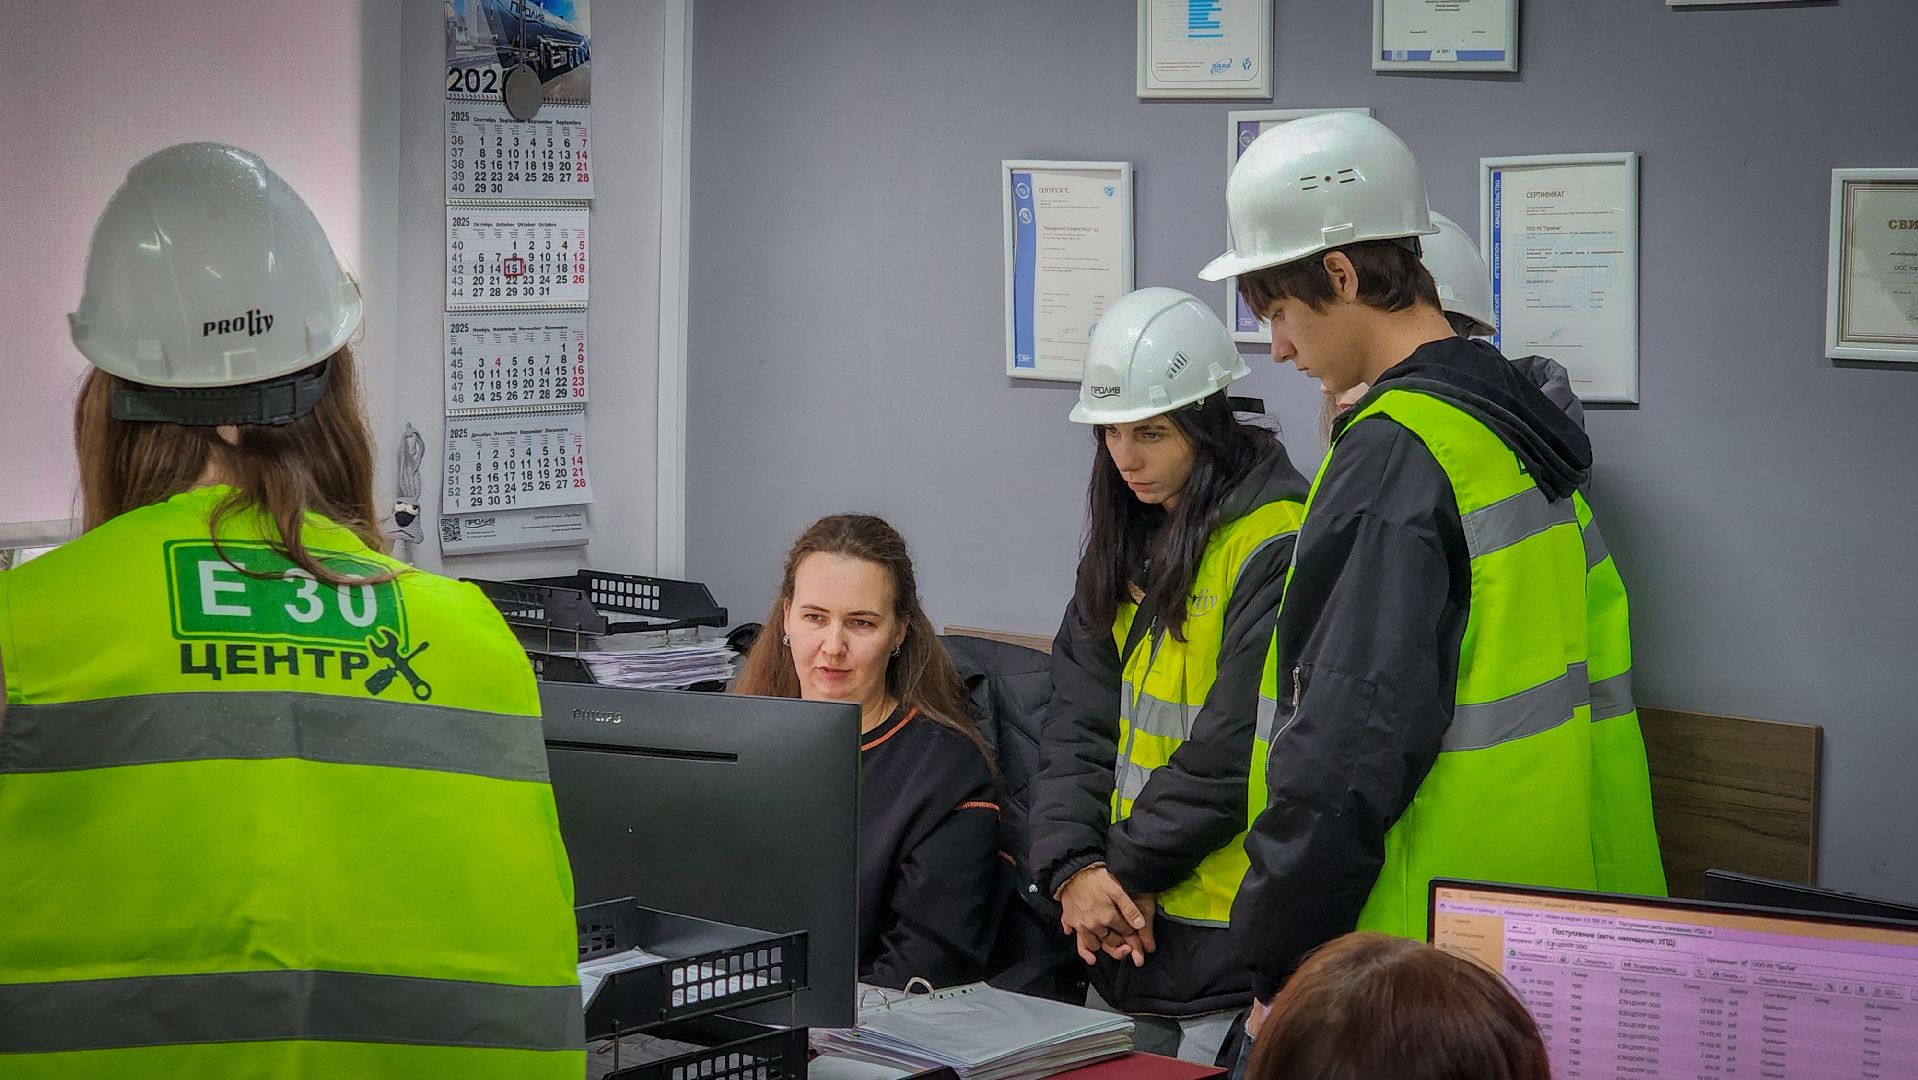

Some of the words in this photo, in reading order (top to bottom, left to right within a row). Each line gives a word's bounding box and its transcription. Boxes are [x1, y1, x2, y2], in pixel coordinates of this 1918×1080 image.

[448, 67, 498, 93] 202
[451, 112, 469, 121] 2025
[480, 136, 484, 146] 1
[497, 137, 502, 146] 2
[514, 137, 519, 146] 3
[530, 138, 536, 147] 4
[548, 138, 553, 147] 5
[564, 138, 570, 148] 6
[582, 139, 587, 148] 7
[480, 148, 486, 158] 8
[497, 149, 502, 158] 9
[508, 149, 519, 158] 10
[525, 149, 535, 158] 11
[542, 150, 553, 159] 12
[559, 150, 570, 159] 13
[576, 151, 587, 160] 14
[474, 160, 486, 169] 15
[491, 160, 502, 170] 16
[508, 161, 519, 170] 17
[525, 161, 536, 170] 18
[542, 161, 553, 170] 19
[559, 162, 571, 171] 20
[576, 162, 587, 171] 21
[475, 172, 486, 181] 22
[491, 172, 502, 181] 23
[508, 172, 519, 181] 24
[525, 172, 536, 182] 25
[542, 173, 554, 182] 26
[560, 173, 571, 182] 27
[577, 173, 589, 182] 28
[475, 183, 486, 192] 29
[491, 184, 502, 193] 30
[453, 217, 470, 226] 2025
[513, 241, 516, 250] 1
[529, 241, 534, 250] 2
[546, 241, 550, 250] 3
[562, 241, 568, 249] 4
[580, 241, 584, 250] 5
[479, 253, 484, 262] 6
[496, 253, 501, 262] 7
[529, 253, 534, 262] 9
[540, 253, 550, 261] 10
[556, 252, 566, 261] 11
[573, 252, 585, 261] 12
[473, 264, 484, 274] 13
[490, 264, 501, 273] 14
[507, 264, 518, 273] 15
[523, 264, 534, 273] 16
[540, 264, 550, 273] 17
[556, 264, 567, 272] 18
[573, 264, 584, 273] 19
[473, 276, 484, 285] 20
[490, 276, 499, 285] 21
[506, 276, 518, 284] 22
[523, 276, 534, 284] 23
[539, 275, 550, 284] 24
[556, 275, 567, 284] 25
[573, 275, 584, 283] 26
[473, 288, 484, 297] 27
[490, 288, 501, 296] 28
[506, 287, 517, 296] 29
[523, 287, 534, 296] 30
[539, 287, 549, 296] 31
[450, 323, 469, 333] 2025
[1091, 386, 1120, 394] ПРОЛИВ
[450, 429, 467, 439] 2025
[477, 450, 480, 459] 1
[493, 450, 498, 458] 2
[510, 449, 514, 458] 3
[526, 448, 531, 456] 4
[543, 446, 548, 456] 5
[560, 446, 565, 454] 6
[576, 445, 582, 454] 7
[476, 463, 481, 471] 8
[493, 461, 498, 470] 9
[504, 460, 515, 469] 10
[521, 459, 530, 469] 11
[538, 458, 549, 468] 12
[554, 457, 566, 466] 13
[572, 456, 583, 465] 14
[470, 474, 481, 483] 15
[488, 473, 499, 482] 16
[504, 472, 515, 481] 17
[521, 471, 533, 480] 18
[538, 469, 549, 479] 19
[555, 469, 567, 478] 20
[572, 467, 583, 476] 21
[470, 486, 482, 495] 22
[488, 484, 499, 494] 23
[504, 483, 516, 493] 24
[522, 482, 533, 491] 25
[539, 481, 550, 490] 26
[556, 480, 568, 489] 27
[573, 479, 586, 487] 28
[284, 568, 377, 627] 30
[181, 644, 369, 680] ЦЕНТР
[572, 708, 622, 724] PHILIPS
[1552, 928, 1595, 938] Поступление
[1597, 933, 1616, 941] (акты,
[1618, 936, 1656, 945] накладные,
[1658, 939, 1676, 947] УПД)
